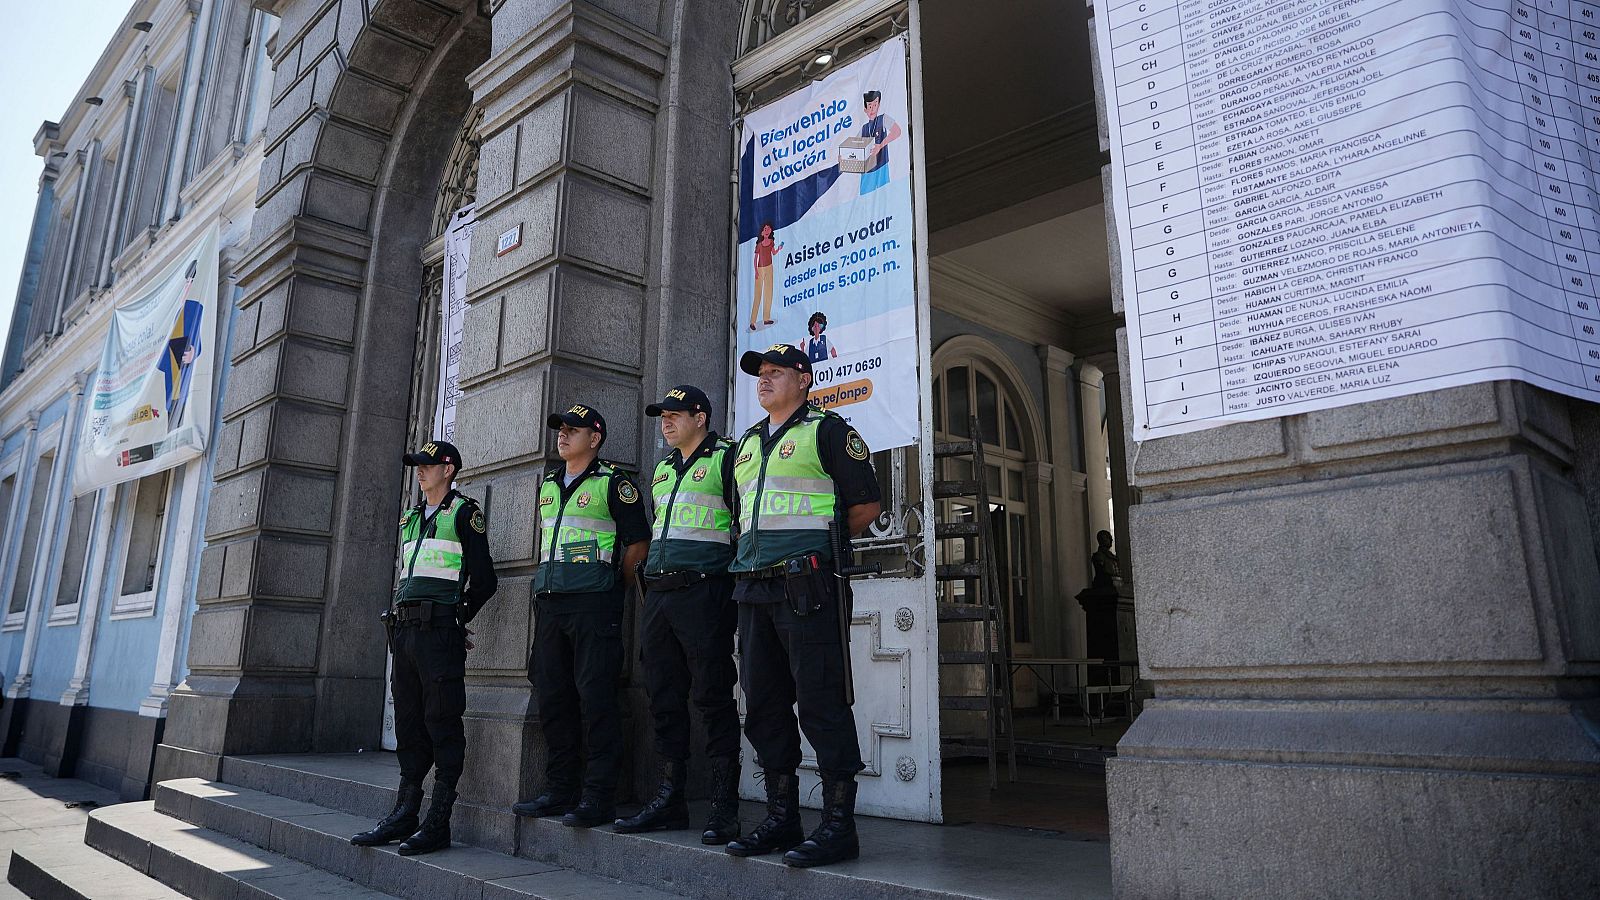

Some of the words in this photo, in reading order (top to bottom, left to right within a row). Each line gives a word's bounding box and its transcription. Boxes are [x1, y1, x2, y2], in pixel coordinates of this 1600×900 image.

[1139, 4, 1146, 12] C
[1141, 23, 1148, 31] C
[1139, 41, 1155, 52] CH
[1142, 60, 1157, 71] CH
[1148, 81, 1155, 90] D
[760, 99, 847, 148] Bienvenido
[1150, 101, 1158, 110] D
[793, 124, 829, 155] local
[834, 115, 852, 134] de
[1153, 121, 1160, 130] D
[1156, 141, 1162, 150] E
[1231, 170, 1263, 186] FLORES
[1300, 149, 1327, 165] MARIA
[1329, 131, 1381, 155] FRANCISCA
[1232, 172, 1288, 196] FUSTAMANTE
[1334, 146, 1370, 165] LYHARA
[1372, 128, 1426, 153] ANGELINNE
[762, 149, 826, 188] votación
[1158, 162, 1164, 171] E
[1160, 183, 1167, 191] F
[1234, 191, 1269, 208] GABRIEL
[1315, 169, 1342, 184] EDITA
[1235, 202, 1266, 219] GARCIA
[1304, 181, 1335, 198] ALDAIR
[1236, 215, 1268, 231] GARCIA
[1305, 193, 1343, 210] JESSICA
[1344, 179, 1388, 199] VANESSA
[1162, 204, 1169, 213] F
[1237, 221, 1283, 241] GONZALES
[1309, 205, 1340, 221] JORGE
[1341, 192, 1384, 212] ANTONIO
[1239, 234, 1284, 253] GONZALES
[1349, 205, 1388, 223] PAMELA
[1389, 189, 1443, 212] ELIZABETH
[502, 232, 516, 249] 1227
[785, 241, 830, 269] Asiste
[834, 235, 844, 249] a
[848, 216, 892, 244] votar
[1164, 225, 1172, 234] G
[1240, 244, 1288, 264] GUTIERREZ
[1330, 224, 1361, 240] JUANA
[1362, 216, 1387, 231] ELBA
[784, 268, 816, 288] desde
[820, 260, 837, 274] las
[840, 248, 866, 268] 7:00
[869, 246, 879, 257] a.
[882, 239, 900, 252] m.
[1166, 247, 1174, 256] G
[1242, 257, 1290, 276] GUTIERREZ
[1328, 234, 1376, 253] PRISCILLA
[1377, 223, 1415, 241] SELENE
[1243, 270, 1279, 287] GUZMAN
[1280, 256, 1335, 277] VELEZMORO
[1337, 252, 1351, 262] DE
[1388, 234, 1419, 249] MARIA
[1421, 220, 1481, 241] ANTONIETA
[784, 288, 814, 307] hasta
[818, 281, 835, 294] las
[839, 268, 866, 287] 5:00
[868, 267, 879, 282] p.
[883, 260, 900, 273] m.
[1168, 269, 1177, 277] G
[1244, 284, 1276, 299] HABICH
[1277, 281, 1289, 291] LA
[1325, 259, 1375, 279] CHRISTIAN
[1377, 248, 1418, 266] FRANCO
[1170, 291, 1179, 300] G
[1245, 294, 1282, 310] HUAMAN
[1330, 273, 1365, 289] MAGNIT
[1247, 307, 1283, 322] HUAMAN
[1285, 303, 1298, 313] DE
[1333, 285, 1375, 302] LUCINDA
[1376, 277, 1409, 292] EMILIA
[1248, 318, 1284, 333] HUYHUA
[1333, 292, 1398, 314] FRANSHESKA
[1399, 284, 1432, 299] NAOMI
[1173, 313, 1181, 322] H
[1318, 316, 1351, 331] ULISES
[1175, 336, 1182, 345] H
[1251, 340, 1294, 357] ICAHUATE
[1329, 325, 1368, 341] SAHARY
[1369, 317, 1403, 332] RHUBY
[1252, 356, 1286, 370] ICHIPAS
[1339, 334, 1389, 353] ESTEFANY
[1391, 328, 1421, 342] SARAI
[815, 367, 833, 385] (01)
[836, 364, 853, 377] 417
[855, 357, 882, 372] 0630
[1253, 364, 1301, 382] IZQUIERDO
[1348, 348, 1386, 363] MIGUEL
[1387, 337, 1438, 355] EDUARDO
[1255, 380, 1293, 395] JACINTO
[1335, 366, 1365, 380] MARIA
[1366, 359, 1399, 374] ELENA
[1256, 393, 1286, 406] JUSTO
[1340, 377, 1370, 391] MARIA
[1372, 373, 1391, 385] LUZ
[1182, 405, 1188, 415] J
